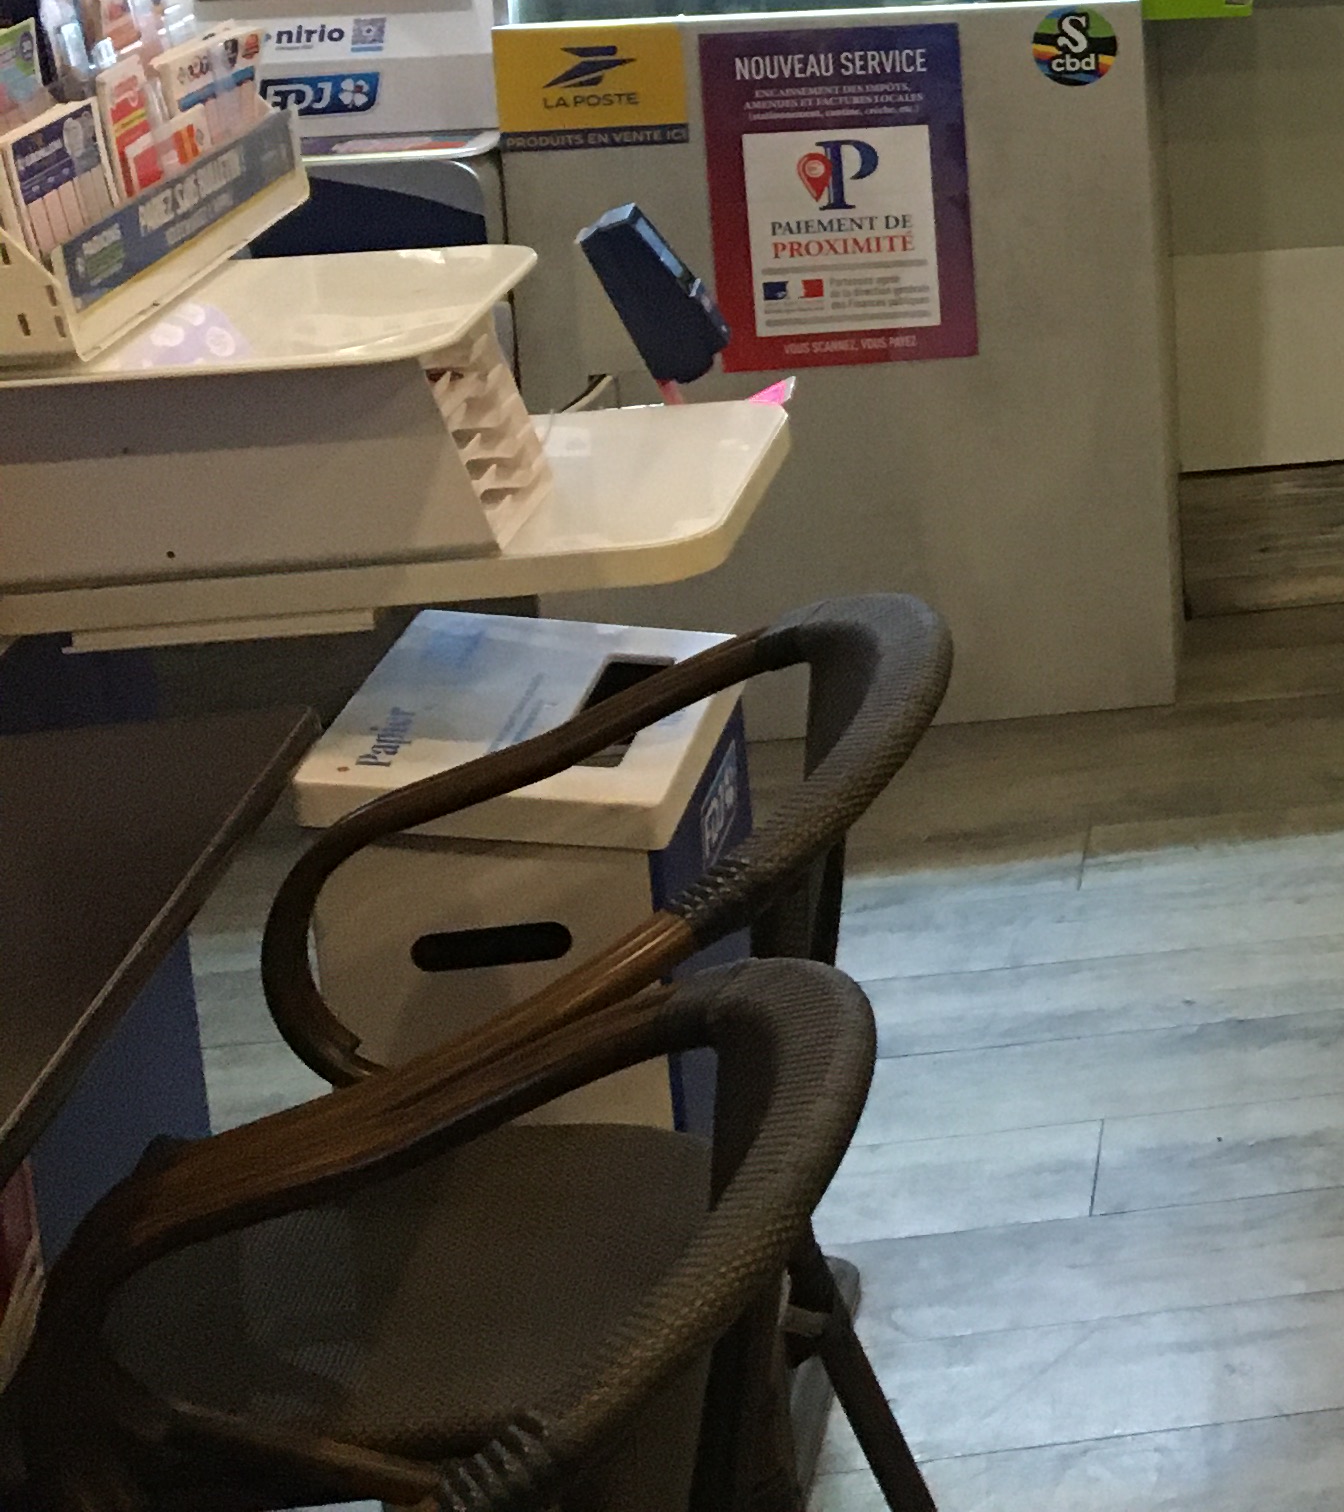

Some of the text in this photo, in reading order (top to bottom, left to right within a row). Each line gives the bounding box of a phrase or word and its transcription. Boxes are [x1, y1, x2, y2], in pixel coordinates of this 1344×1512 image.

[275, 24, 345, 44] nirio
[1056, 15, 1088, 54] S
[735, 48, 927, 81] NOUVEAU SERVICE
[1051, 53, 1096, 72] cbd
[265, 81, 333, 109] FDJ
[543, 92, 640, 109] LA POSTE
[743, 92, 923, 111] AMENDES ET FACTURES LOCALES
[754, 85, 839, 99] ENCAISSEMENT
[841, 83, 863, 95] DES
[507, 127, 687, 148] PRODUITS EN VENTE ICI
[815, 139, 879, 211] P
[771, 214, 912, 237] PAIEMENT DE
[772, 230, 916, 259] PROXIMITÉ
[783, 336, 917, 355] VOUS SCANNEZ, VOUS PAYEZ
